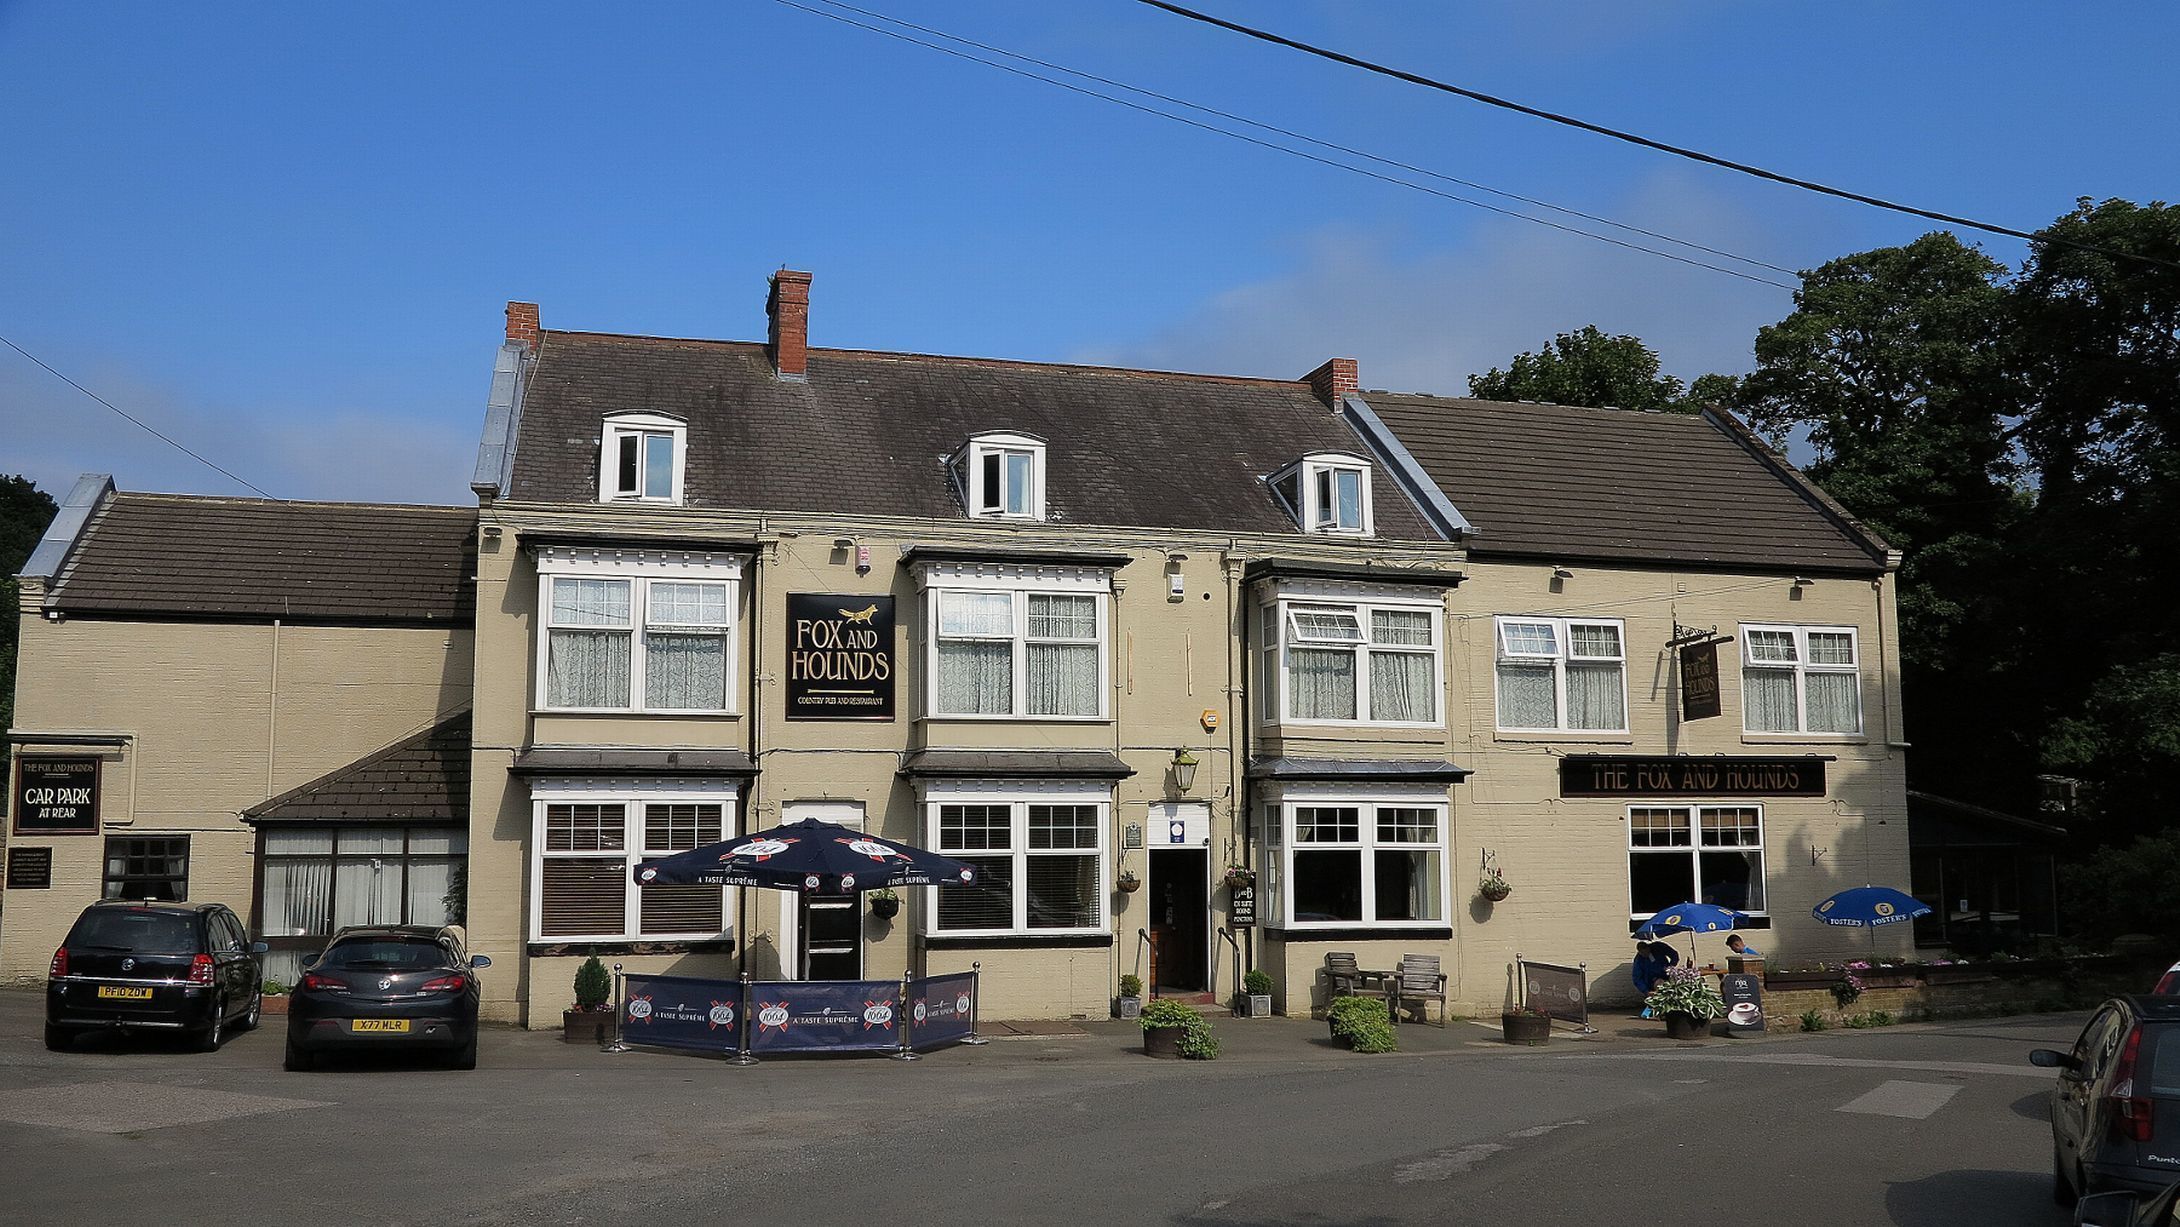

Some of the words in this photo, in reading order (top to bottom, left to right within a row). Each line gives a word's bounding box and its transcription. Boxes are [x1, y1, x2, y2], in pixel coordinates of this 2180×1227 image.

[796, 619, 844, 649] FOX
[846, 629, 878, 649] AND
[791, 651, 890, 681] HOUNDS
[1685, 677, 1716, 696] HOUNDS
[797, 696, 825, 705] COUNTRY
[825, 696, 837, 705] PUB
[837, 697, 850, 705] AND
[849, 697, 883, 706] RESTAURANT
[24, 763, 38, 772] THE
[38, 763, 52, 772] FOX
[52, 763, 67, 772] AND
[67, 763, 94, 772] HOUNDS
[1591, 763, 1630, 790] THE
[1637, 763, 1674, 790] FOX
[1681, 763, 1719, 790] AND
[1726, 764, 1800, 790] HOUNDS
[25, 788, 54, 805] CAR
[56, 788, 91, 805] PARK
[38, 807, 51, 818] AT
[52, 807, 77, 818] REAR
[704, 876, 723, 884] TASTE
[1246, 886, 1254, 899] B
[1830, 918, 1862, 927] FOSTER'S
[1871, 913, 1907, 926] FOSTER'S
[761, 1010, 785, 1023] 1664
[792, 1017, 798, 1025] A
[801, 1017, 821, 1025] TASTE
[824, 1015, 859, 1024] SUPRÊME
[866, 1008, 890, 1022] 1664
[360, 1020, 380, 1030] X77
